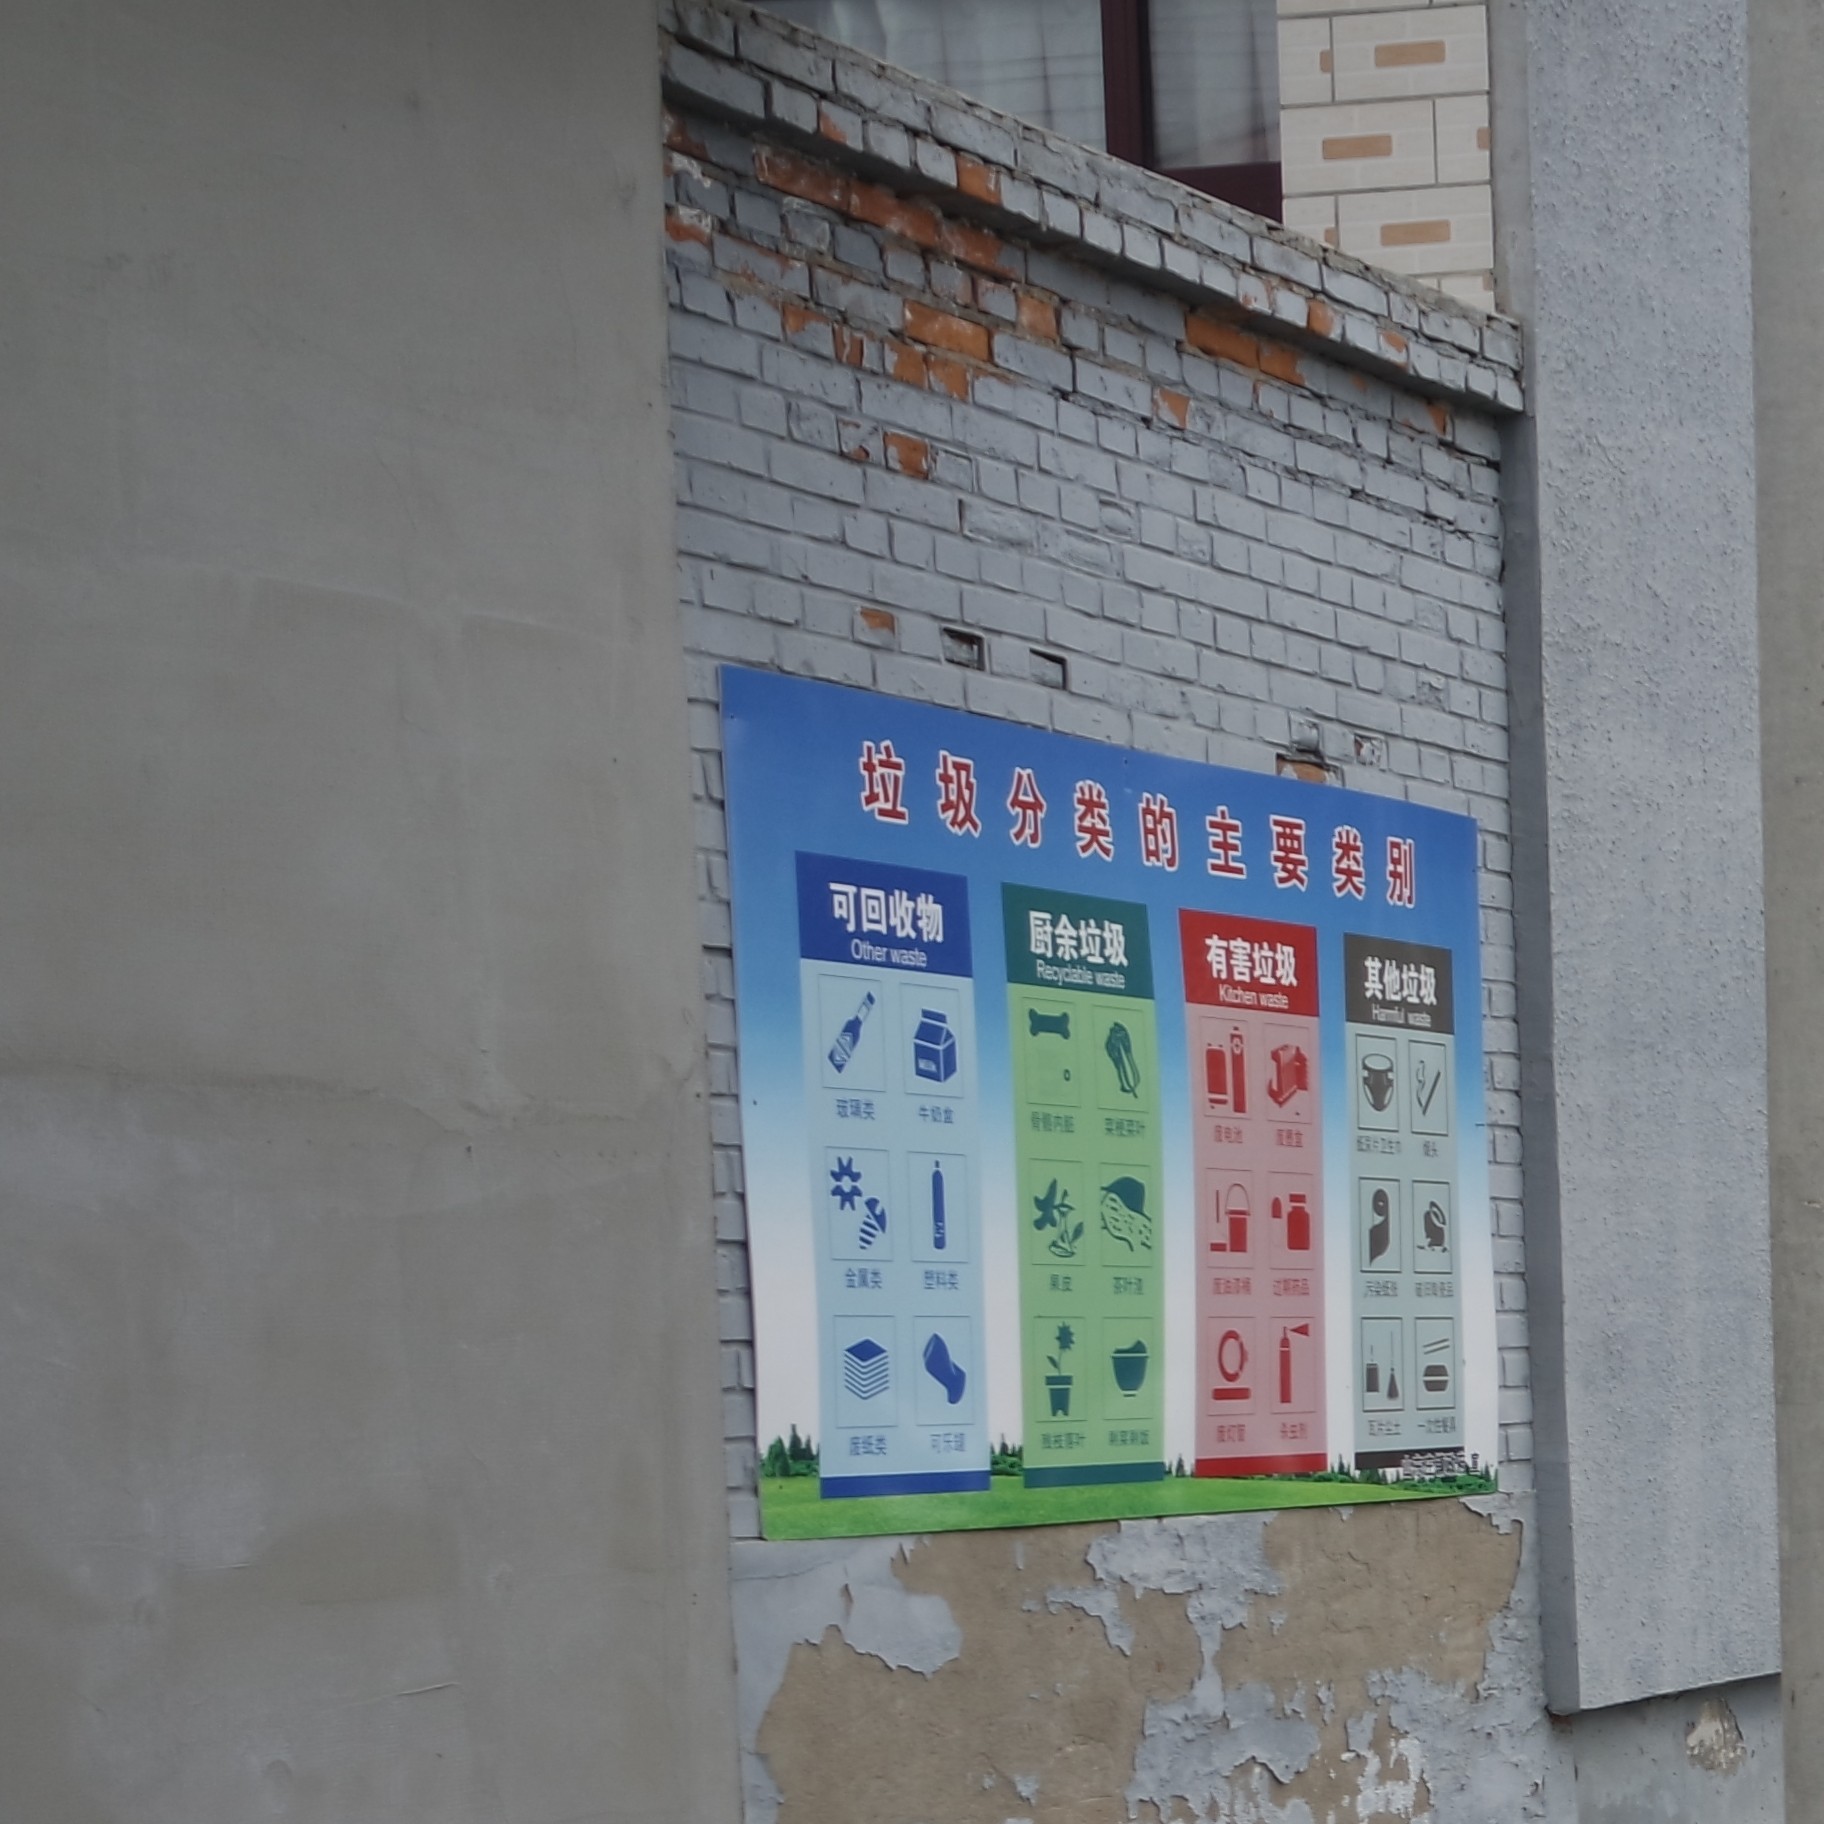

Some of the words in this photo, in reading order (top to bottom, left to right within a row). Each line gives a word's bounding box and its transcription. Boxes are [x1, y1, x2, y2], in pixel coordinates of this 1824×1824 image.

[860, 740, 1416, 908] 垃圾分类的主要类别
[829, 882, 944, 943] 可回收物
[1029, 910, 1128, 967] 厨余垃圾
[851, 938, 887, 963] Other
[890, 947, 927, 968] waste
[1206, 934, 1298, 987] 有害垃圾
[1036, 959, 1093, 986] Recyclable
[1095, 970, 1126, 990] waste
[1364, 956, 1437, 1006] 其他垃圾
[1219, 984, 1256, 1006] Kitchen
[1259, 991, 1289, 1009] waste
[1372, 1003, 1405, 1024] Harmful
[1408, 1010, 1431, 1028] waste
[836, 1098, 875, 1121] 玻璃类
[918, 1105, 953, 1124] 牛奶盒
[845, 1268, 882, 1290] 金属类
[923, 1268, 960, 1290] 塑料类
[849, 1435, 887, 1457] 废纸类
